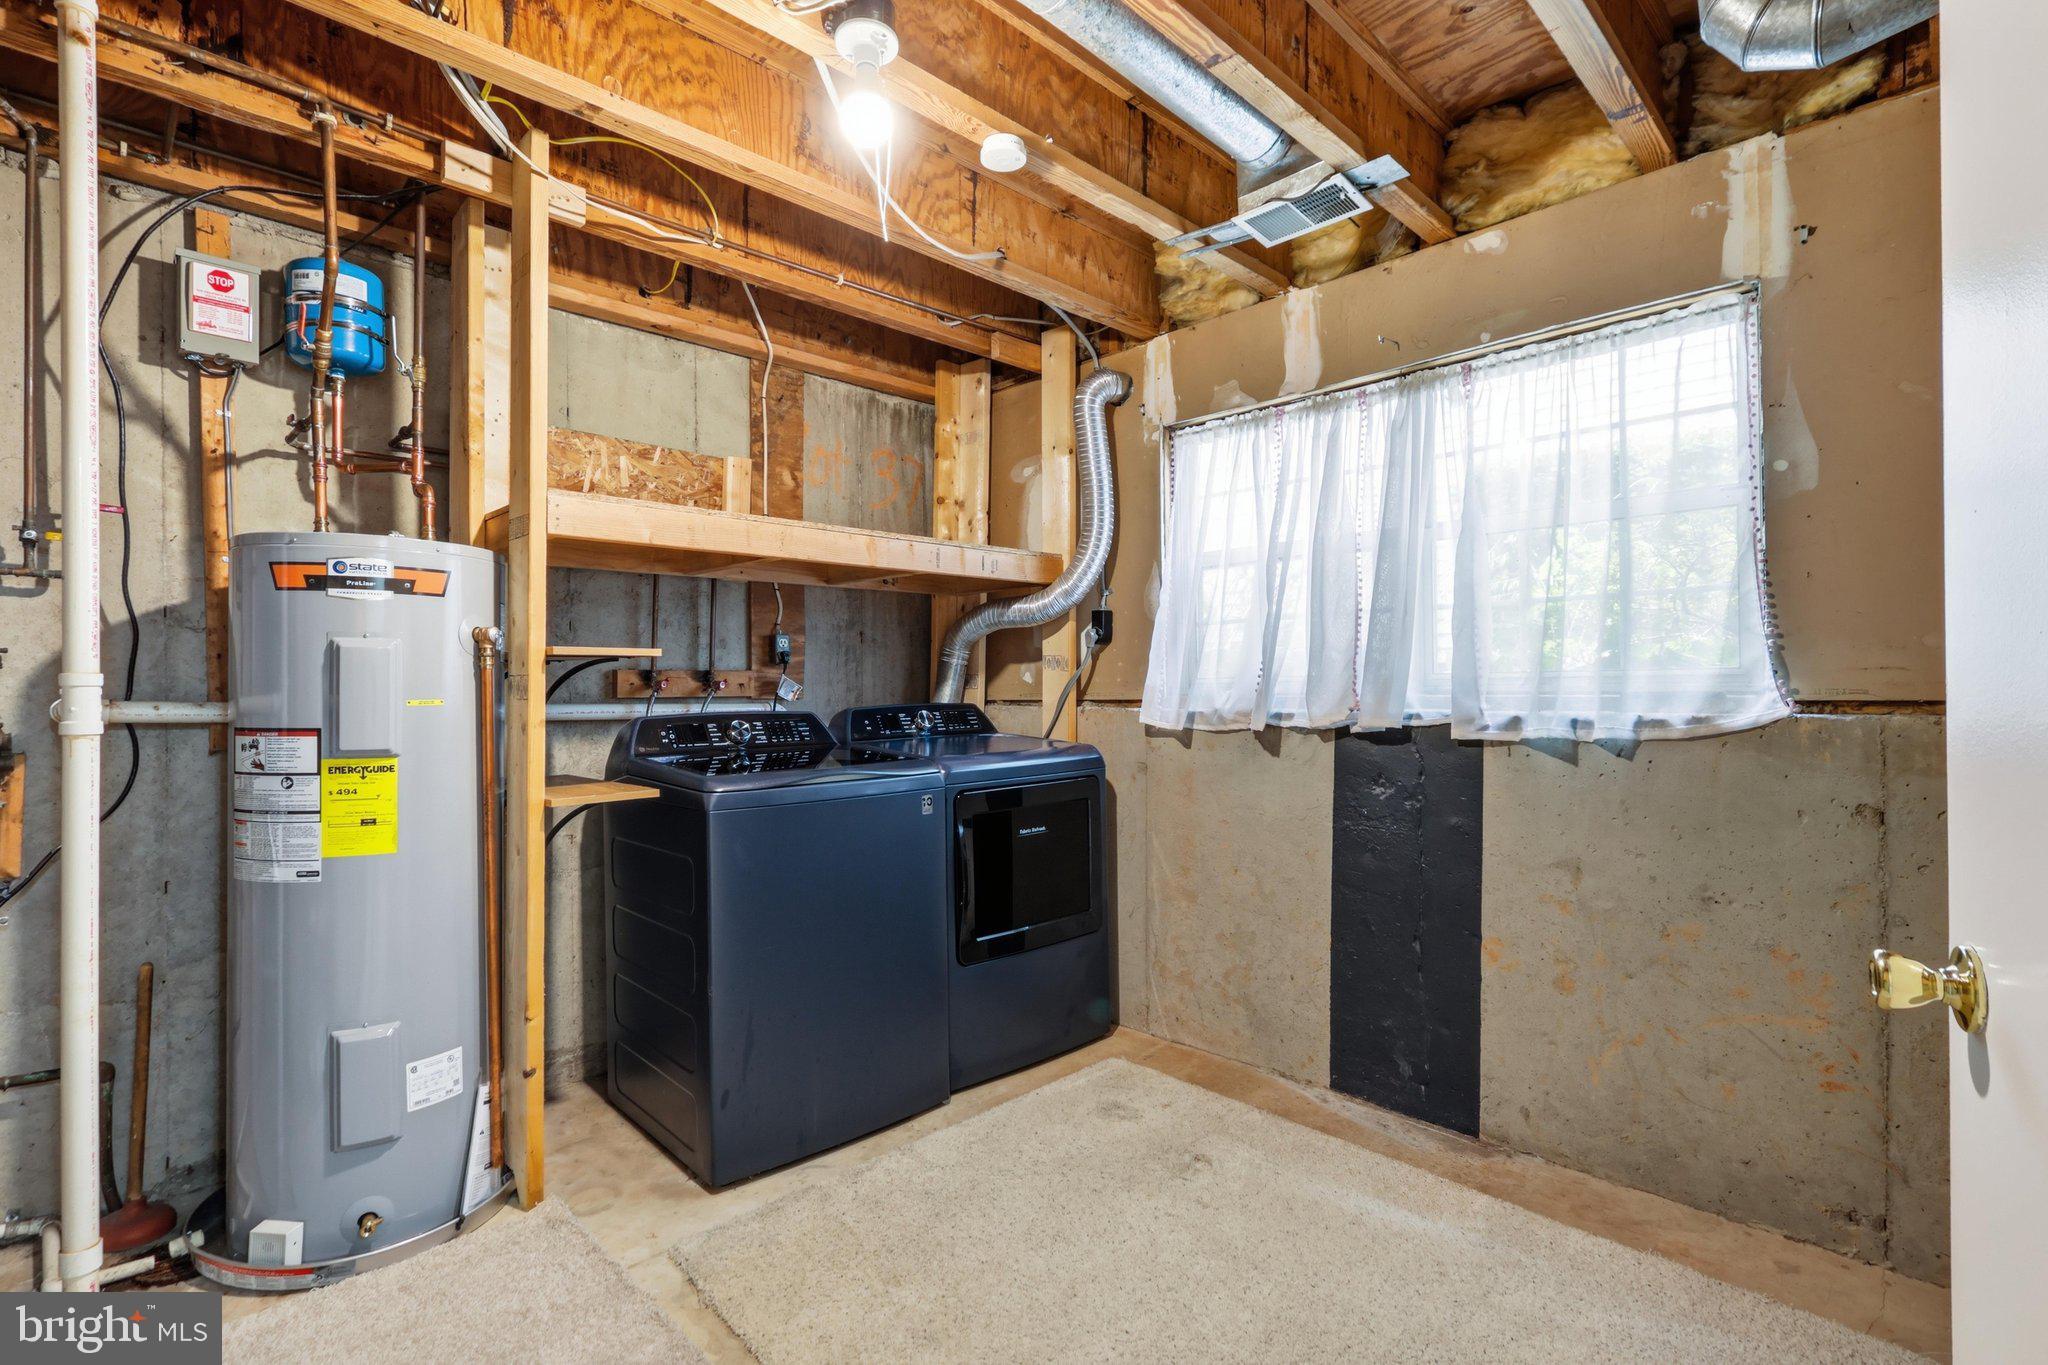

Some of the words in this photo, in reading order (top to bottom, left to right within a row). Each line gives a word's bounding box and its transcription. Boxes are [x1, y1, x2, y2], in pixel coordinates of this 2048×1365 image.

[208, 274, 234, 288] STOP
[349, 563, 388, 572] state
[336, 788, 358, 796] 494
